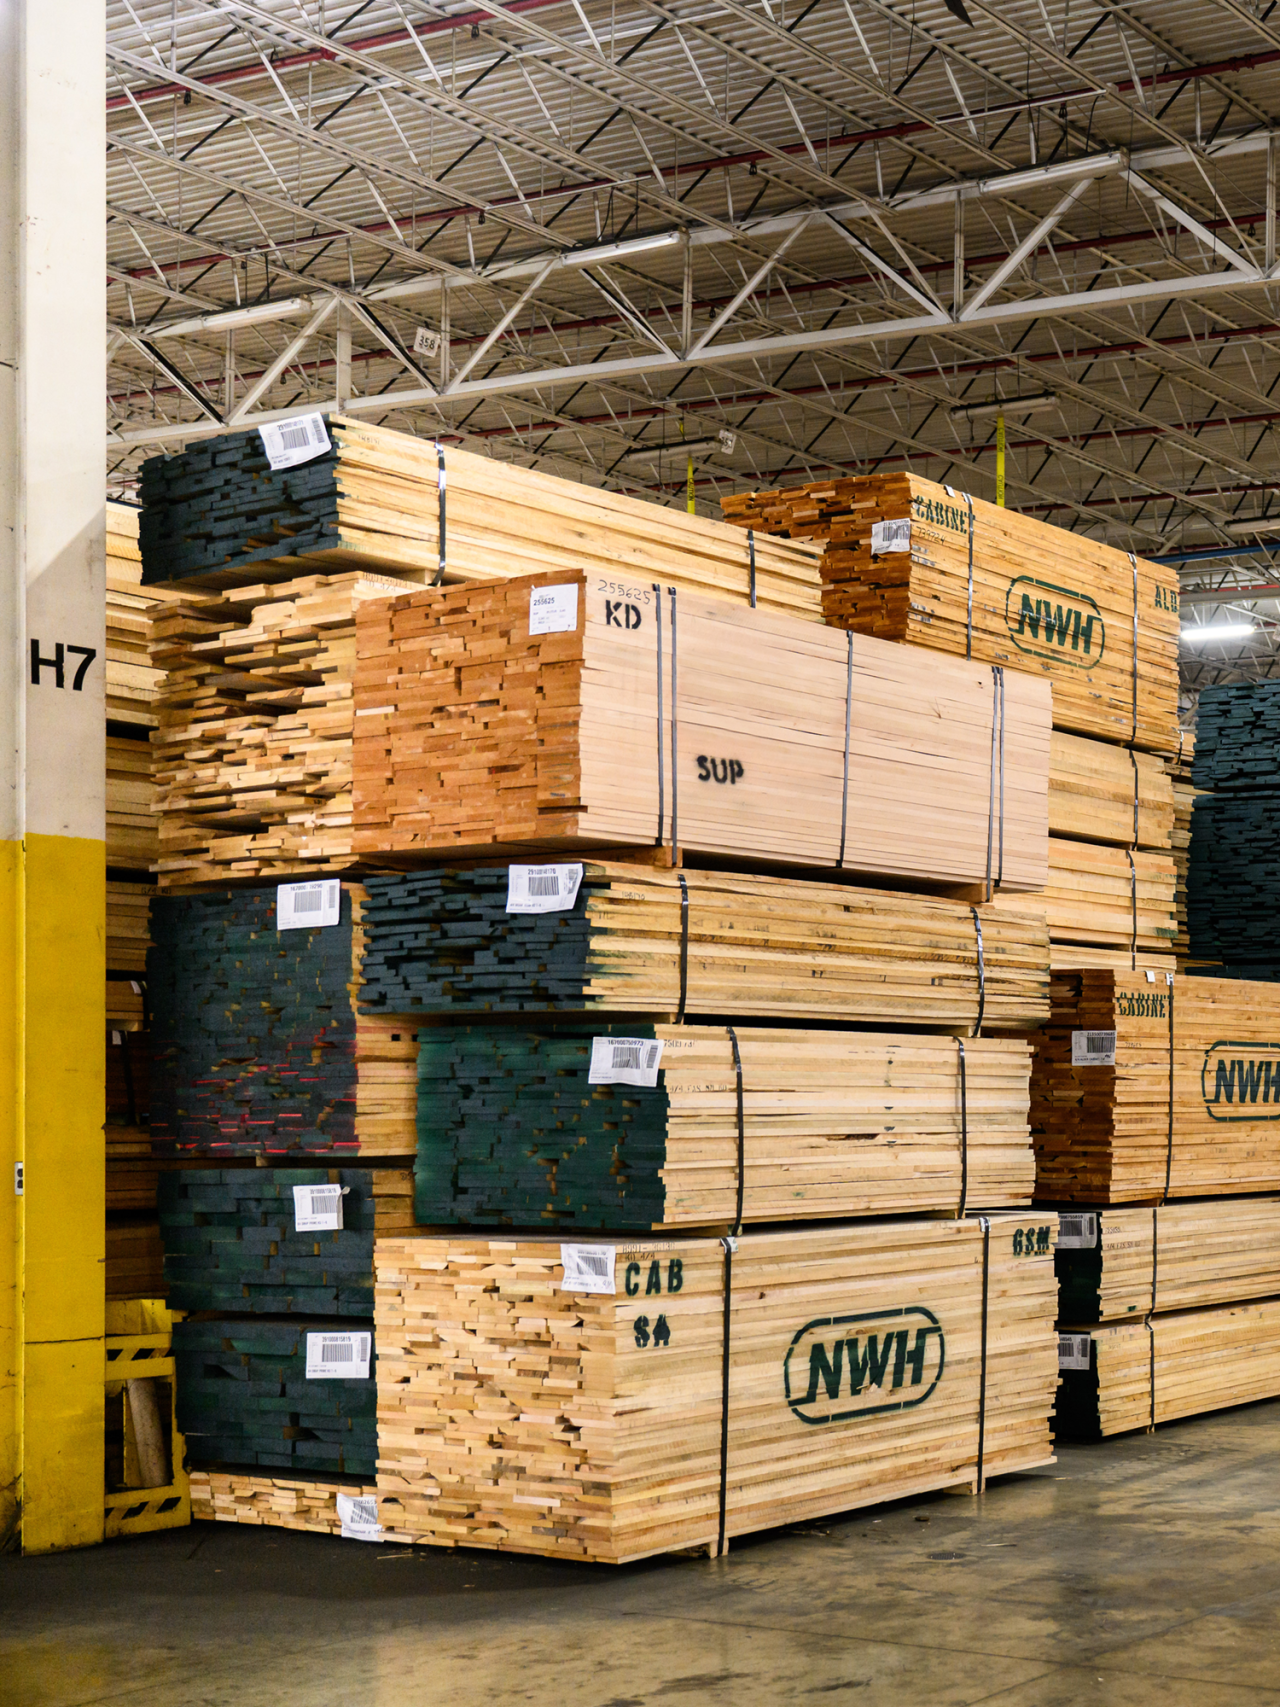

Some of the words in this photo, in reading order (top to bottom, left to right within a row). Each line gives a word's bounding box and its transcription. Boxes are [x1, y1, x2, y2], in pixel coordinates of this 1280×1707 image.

[533, 597, 555, 606] 255625
[598, 579, 651, 605] 255625
[605, 599, 642, 630] KD
[1008, 592, 1103, 655] NWH
[30, 638, 97, 692] H7
[696, 754, 744, 785] SUP
[625, 1258, 684, 1297] CAB
[788, 1326, 942, 1406] NWH
